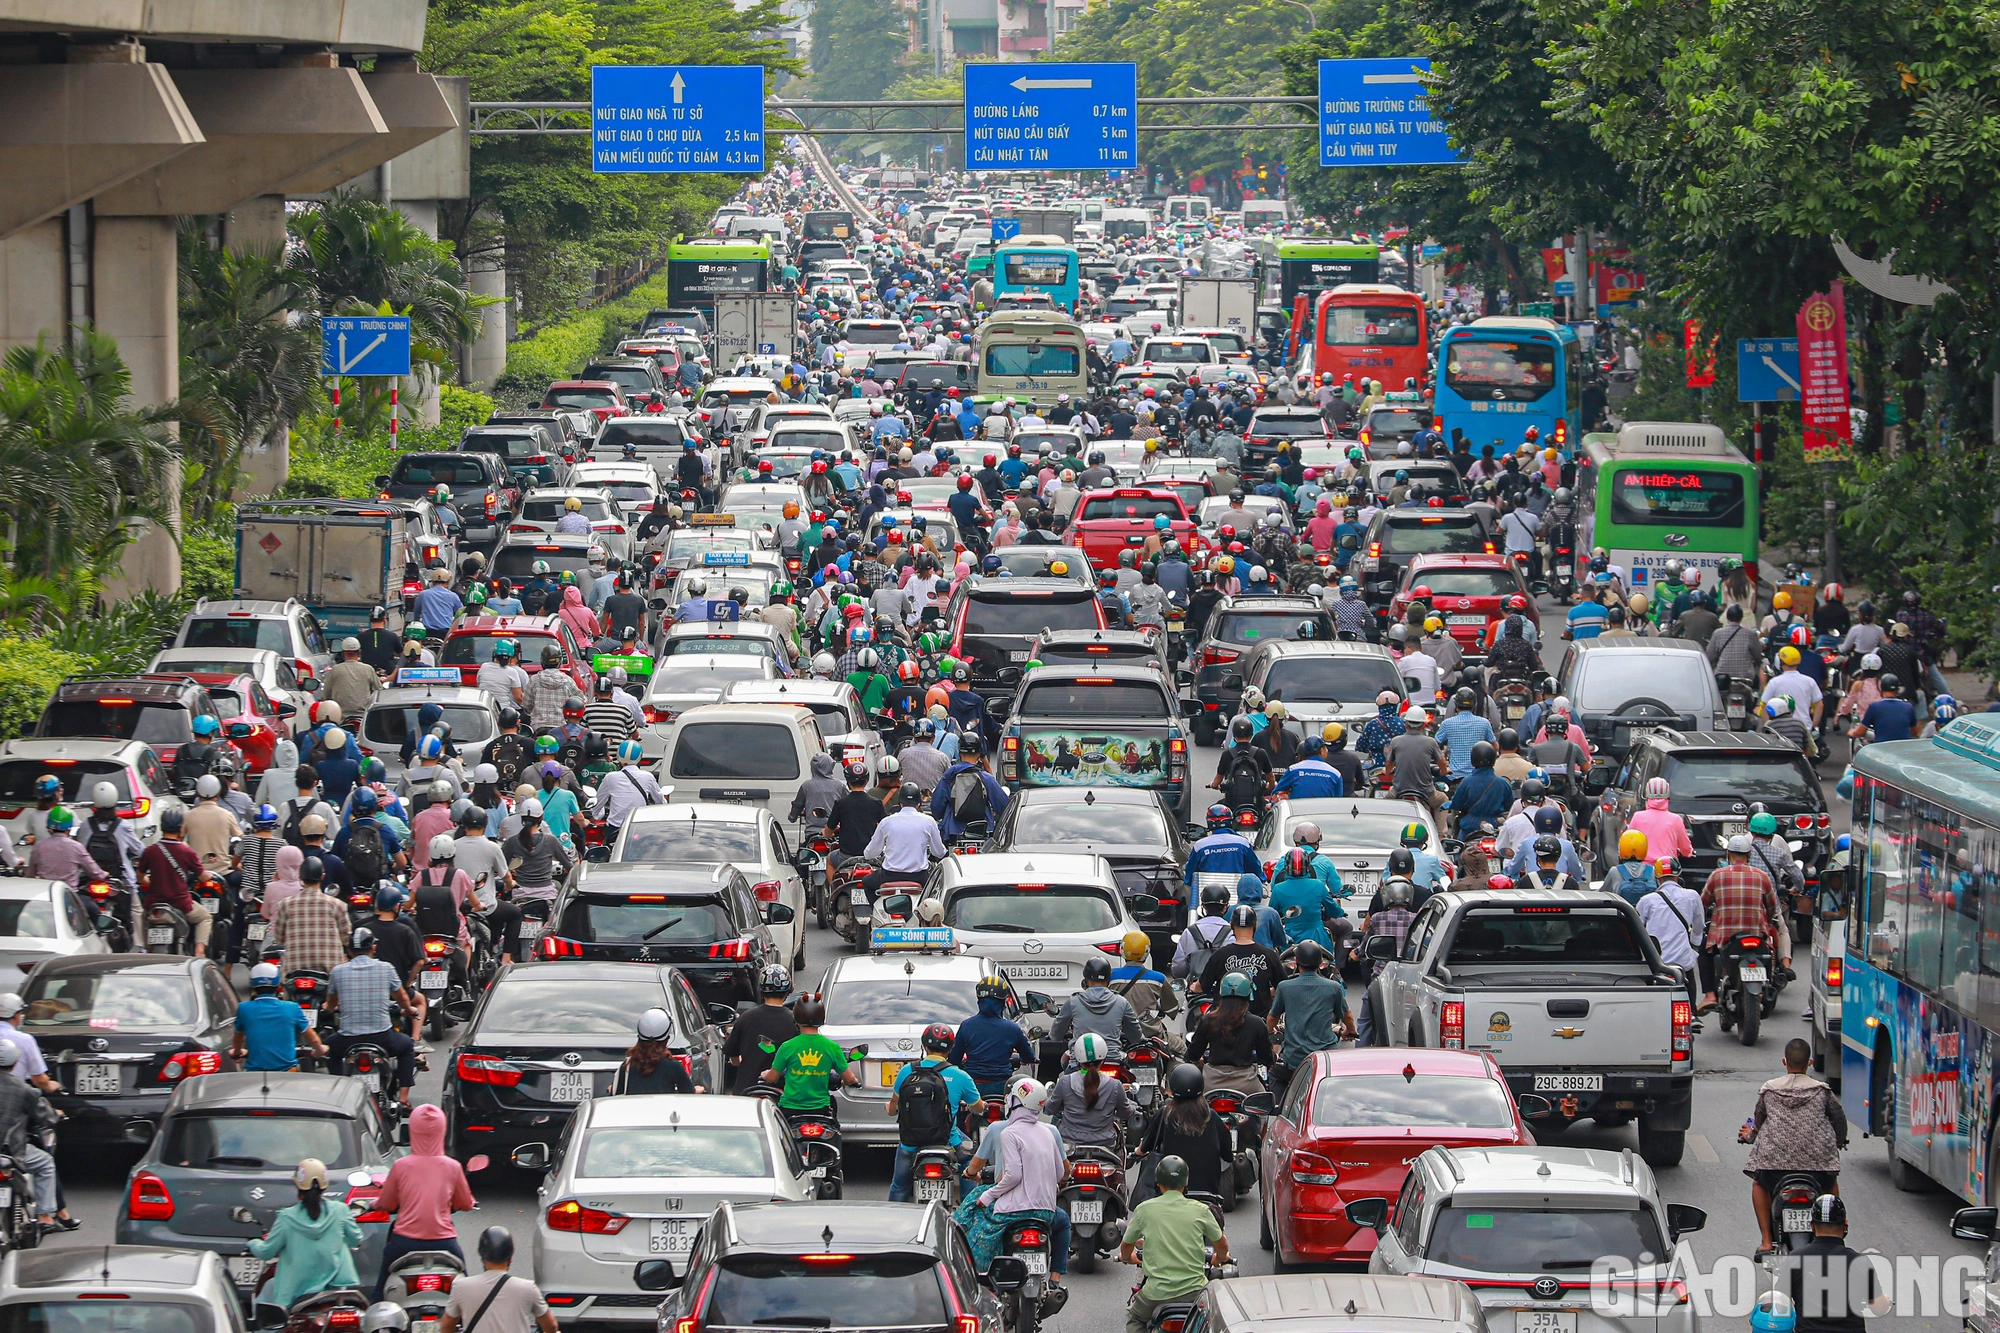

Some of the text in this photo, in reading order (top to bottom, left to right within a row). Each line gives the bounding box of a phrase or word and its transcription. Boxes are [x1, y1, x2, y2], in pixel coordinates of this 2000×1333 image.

[974, 102, 1008, 118] ĐƯỜNG
[1012, 102, 1039, 118] LÁNG
[1112, 105, 1127, 116] km
[1325, 97, 1360, 114] ĐƯỜNG
[1364, 96, 1404, 112] TRƯỜNG
[597, 104, 704, 120] NÚT GIAO NGÃ TƯ SỞ
[974, 123, 1128, 140] NÚT GIAO CẦU GIẤY 5 km
[1326, 120, 1443, 136] NÚT GIAO NGÃ TƯ VỌNG
[597, 126, 759, 144] NÚT GIAO Ô CHỢ DỪA 2,5 km
[598, 150, 617, 164] VĂN
[620, 147, 644, 164] MIẾU
[648, 147, 674, 164] QUỐC
[677, 148, 690, 164] TỬ
[694, 148, 718, 164] GIÁM
[744, 152, 760, 163] km
[974, 146, 1128, 162] CẦU NHẬT TÂN 11 km
[1326, 141, 1398, 158] CẦU VĨNH TUY
[388, 322, 407, 330] CHINH
[1633, 554, 1653, 565] BẢO
[422, 670, 437, 678] SÔNG
[439, 669, 456, 678] NHUỆ
[1353, 873, 1370, 883] 30E
[902, 929, 925, 941] SÔNG
[928, 928, 950, 941] NHUỆ
[88, 1066, 109, 1078] 29A
[561, 1074, 582, 1086] 30A
[1536, 1077, 1600, 1090] 29C-889.21
[552, 1088, 590, 1100] 291.95
[922, 1190, 944, 1198] 5927
[1076, 1202, 1098, 1211] 18-F1
[1074, 1212, 1100, 1222] 176.45
[661, 1221, 687, 1234] 30E
[1533, 1314, 1559, 1326] 35A
